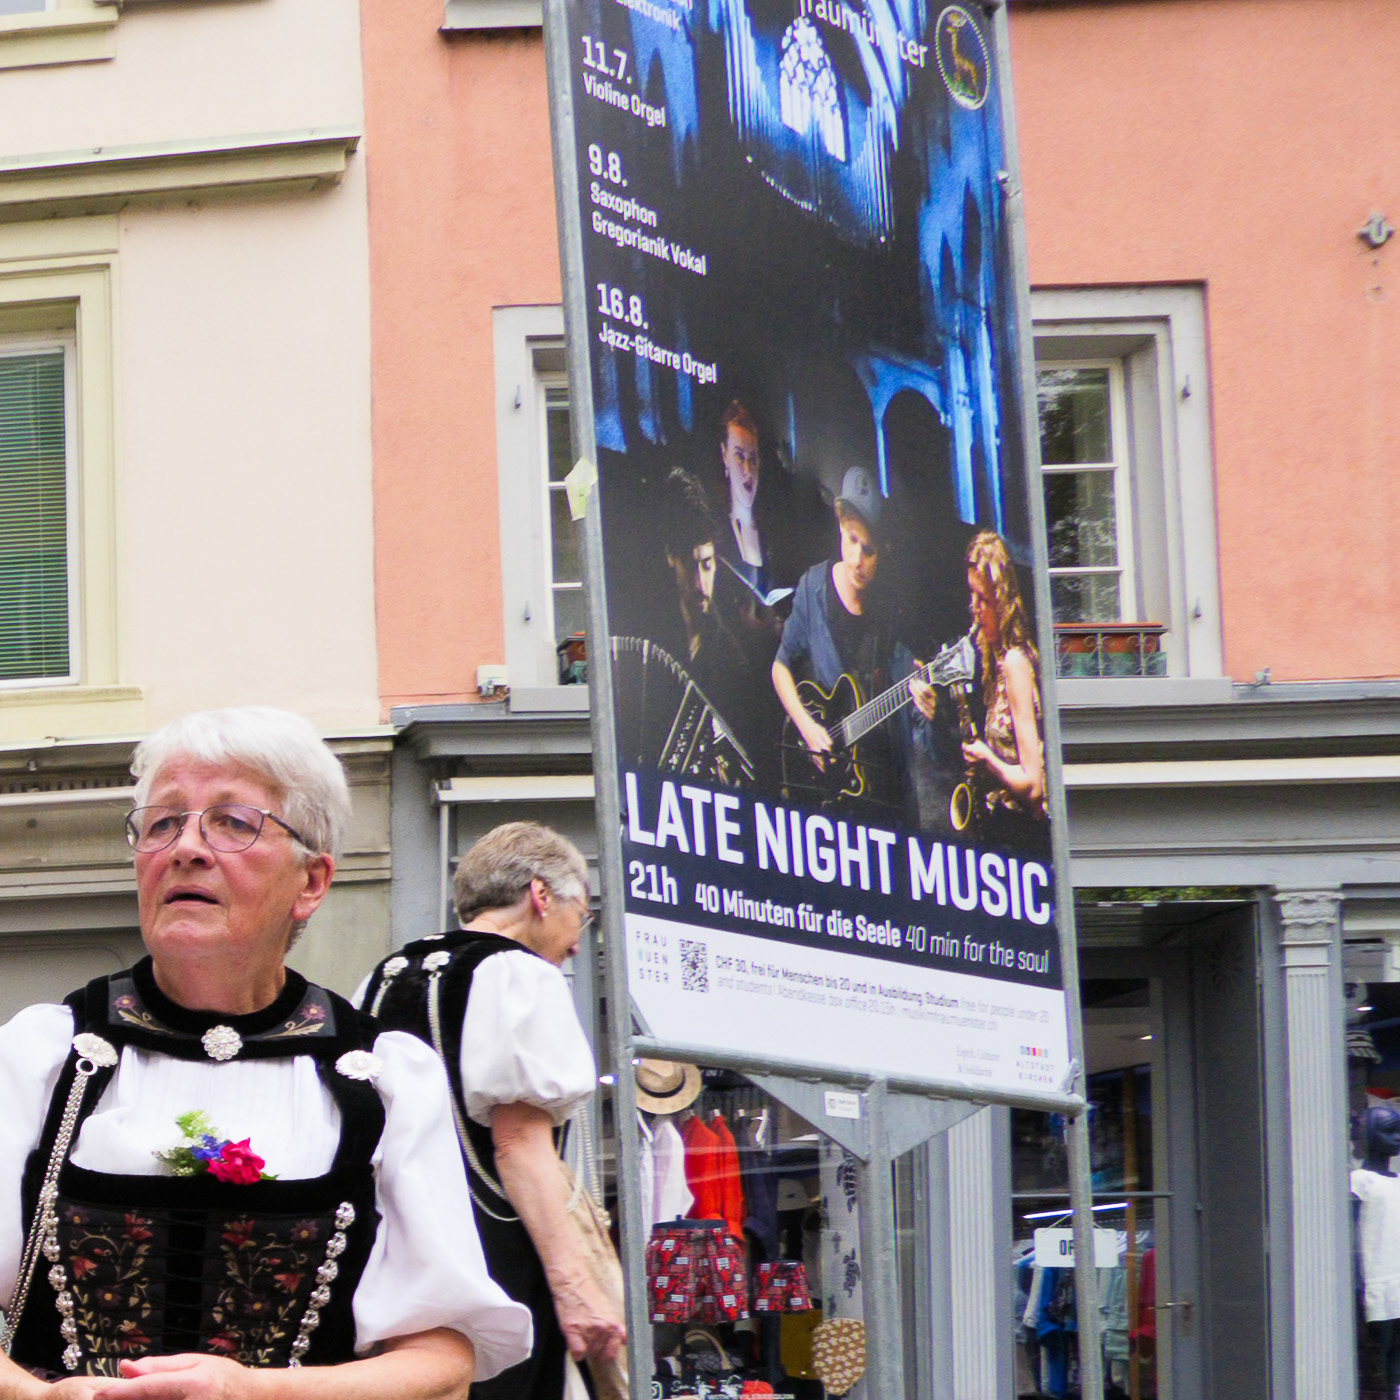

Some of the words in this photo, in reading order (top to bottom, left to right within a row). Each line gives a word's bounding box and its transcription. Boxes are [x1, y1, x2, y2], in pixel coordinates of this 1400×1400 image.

[582, 35, 632, 84] 11.7.
[583, 72, 629, 111] Violine
[631, 94, 666, 127] Orgel
[588, 143, 627, 187] 9.8.
[590, 181, 657, 228] Saxophon
[592, 211, 670, 262] Gregorianik
[669, 243, 707, 275] Vokal
[597, 283, 649, 330] 16.8.
[599, 322, 681, 370] Jazz-Gitarre
[682, 353, 718, 384] Orgel
[625, 772, 744, 864] LATE
[754, 802, 897, 895] NIGHT
[907, 836, 1051, 925] MUSIC
[629, 860, 678, 905] 21h
[695, 882, 720, 913] 40
[722, 888, 795, 928] Minuten
[797, 903, 824, 933] für
[827, 909, 853, 939] die
[855, 914, 901, 948] Seele
[905, 925, 927, 952] 40
[930, 931, 959, 958] min
[963, 935, 986, 962] for
[989, 941, 1014, 968] the
[1017, 950, 1049, 974] soul
[636, 930, 668, 947] FRAU
[639, 968, 669, 983] STER
